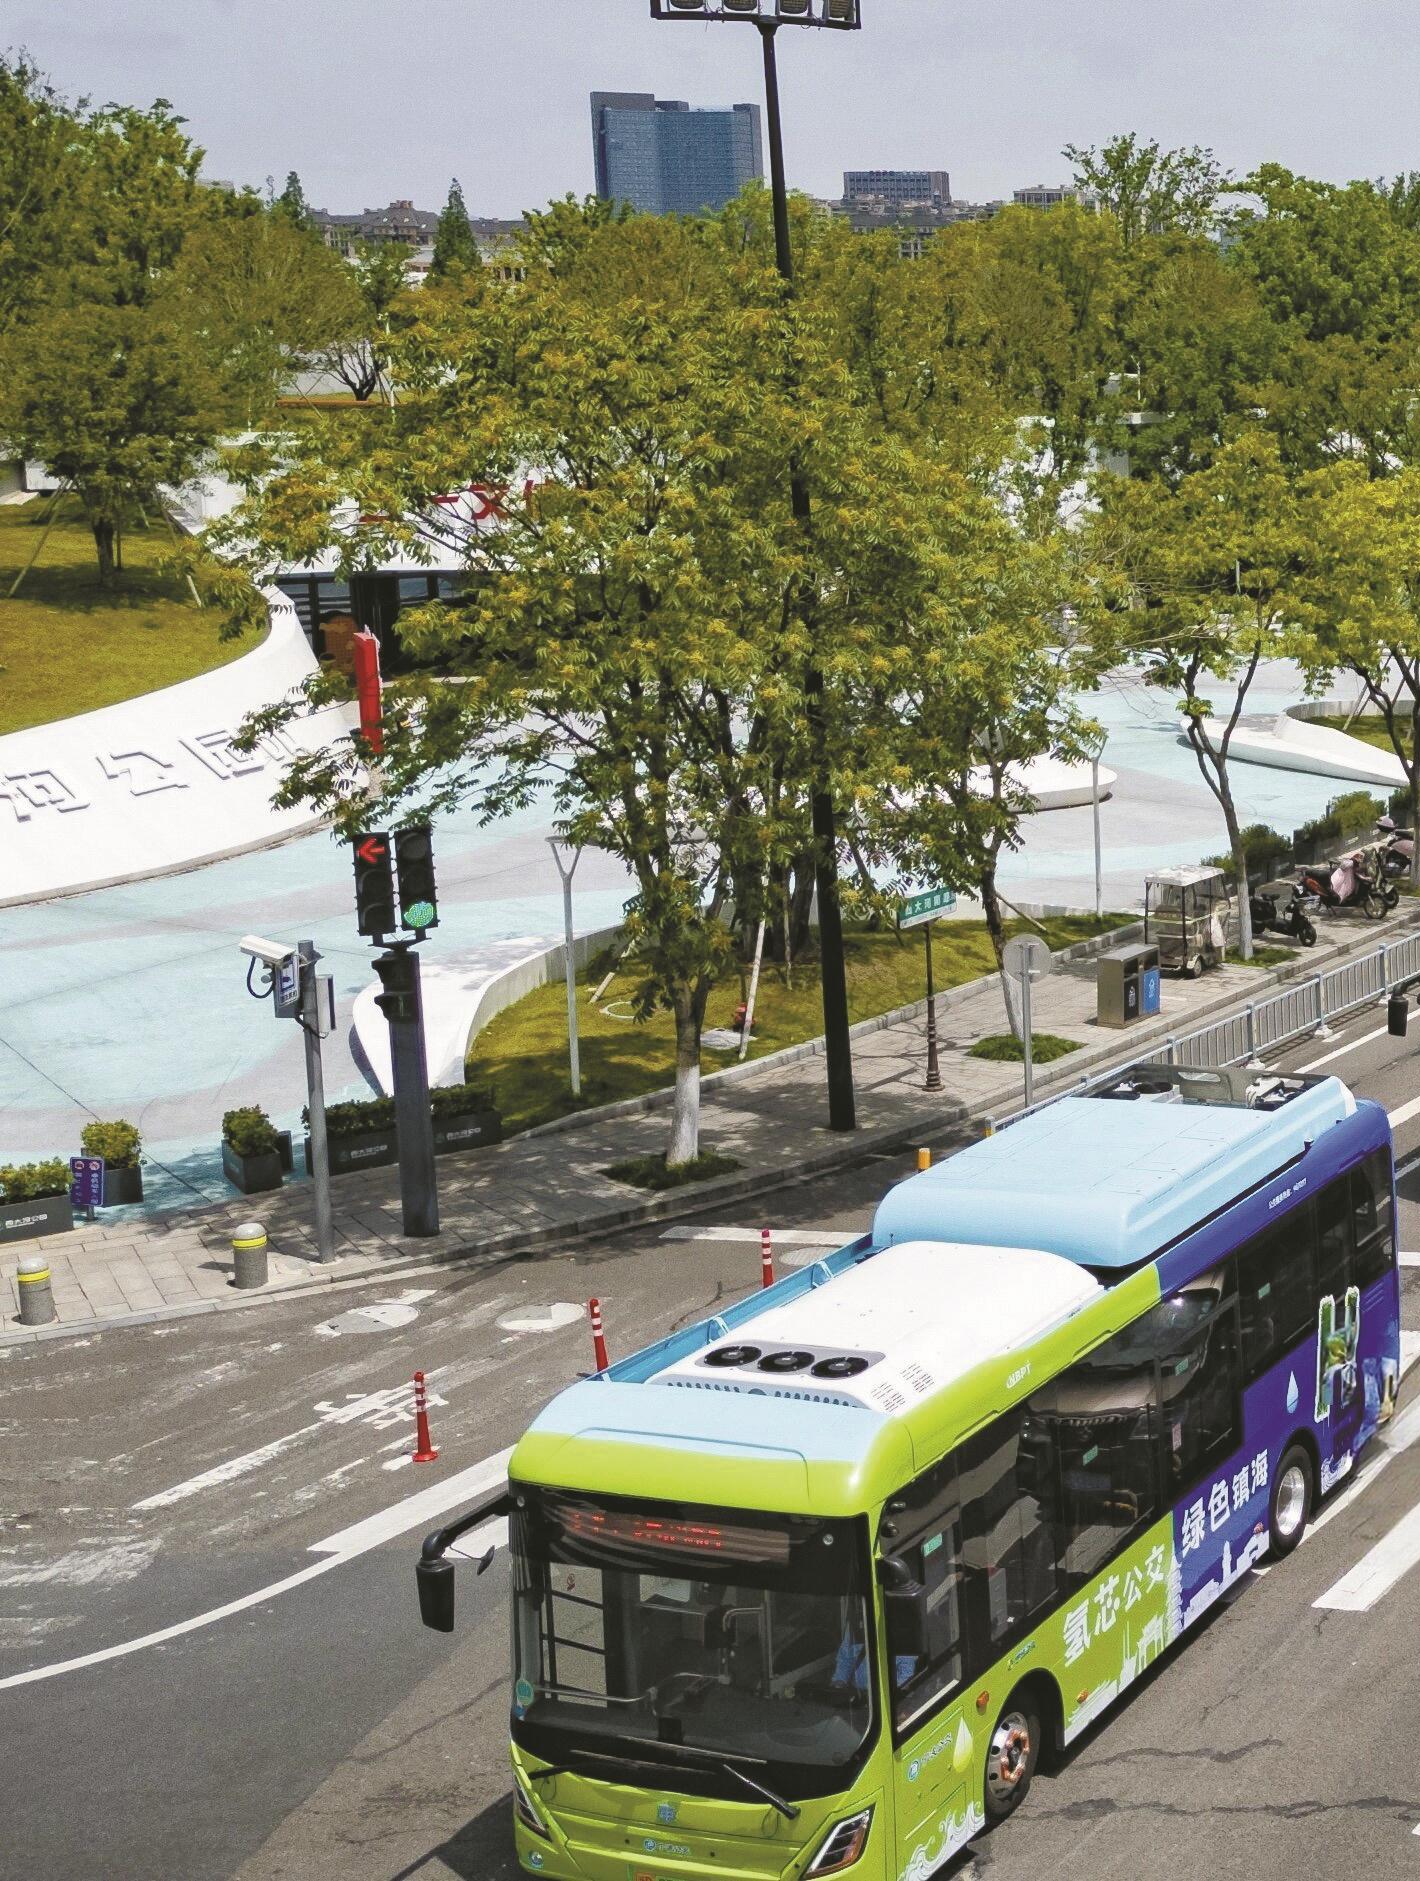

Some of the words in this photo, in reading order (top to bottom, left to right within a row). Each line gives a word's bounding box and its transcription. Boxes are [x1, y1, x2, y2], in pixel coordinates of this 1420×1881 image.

[1062, 1543, 1165, 1668] 氢芯公交
[1180, 1448, 1269, 1559] 绿色镇海
